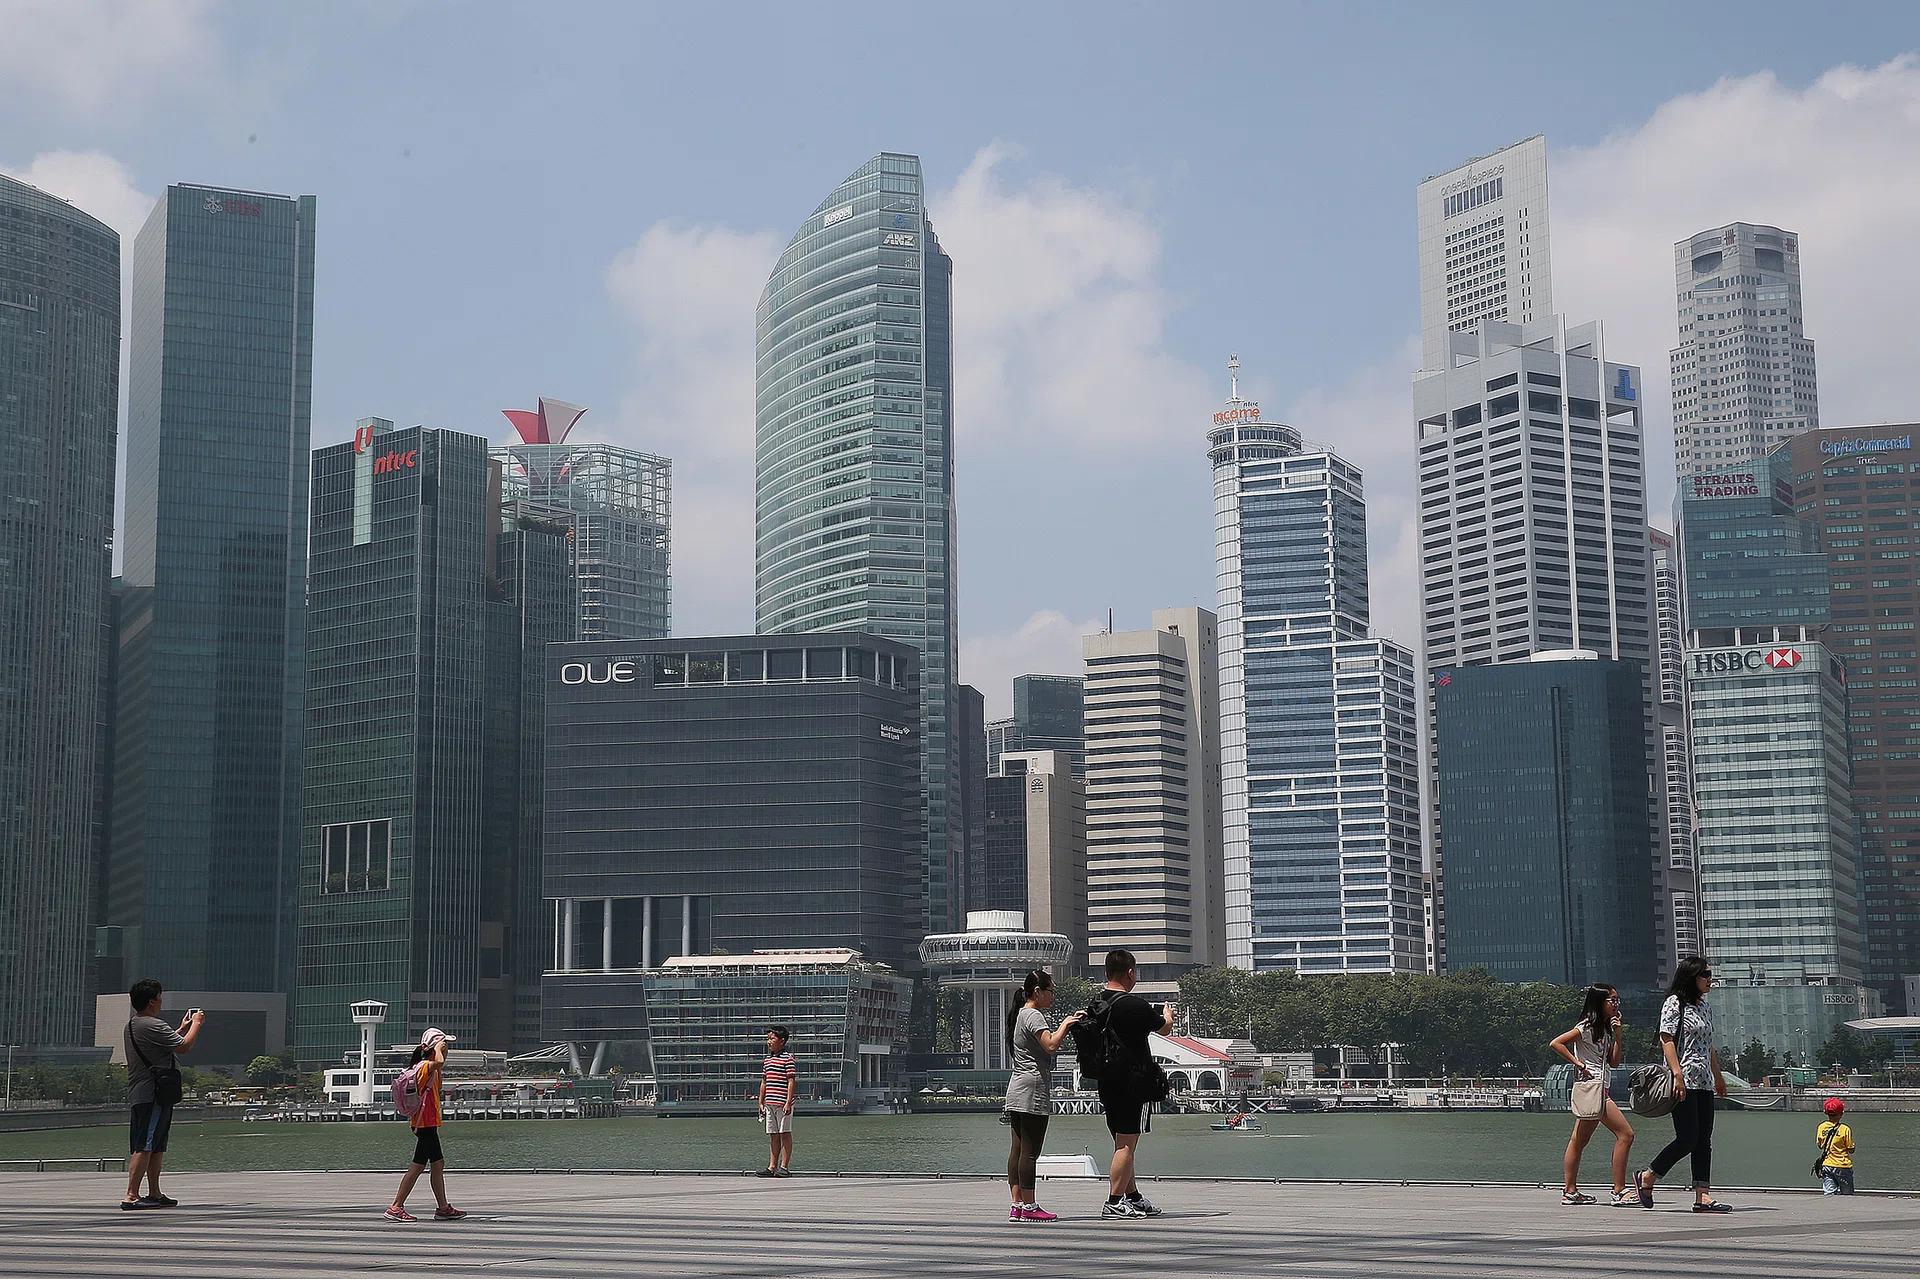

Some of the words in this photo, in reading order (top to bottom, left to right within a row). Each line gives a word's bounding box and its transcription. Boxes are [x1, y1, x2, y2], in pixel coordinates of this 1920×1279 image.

[226, 199, 262, 217] UBS
[883, 233, 914, 247] ANZ
[1213, 408, 1260, 423] income
[374, 450, 416, 475] ntuc
[1694, 474, 1755, 486] STRAITS
[1694, 485, 1759, 497] TRADING
[1694, 650, 1762, 673] HSBC
[561, 661, 636, 685] OUE
[1824, 995, 1846, 1003] HSBC
